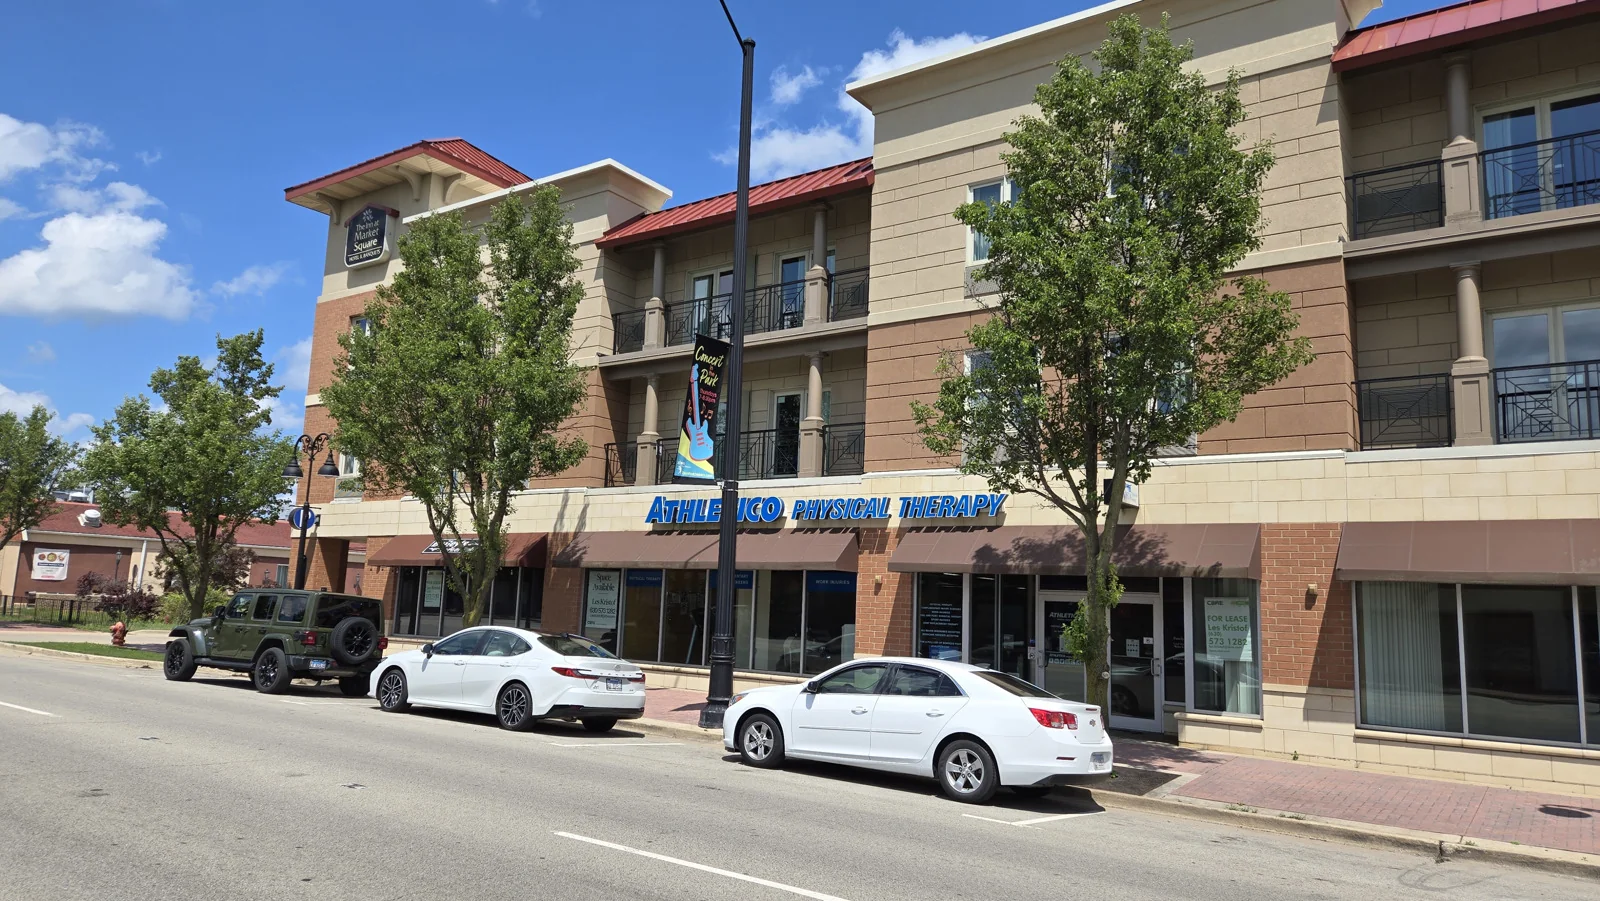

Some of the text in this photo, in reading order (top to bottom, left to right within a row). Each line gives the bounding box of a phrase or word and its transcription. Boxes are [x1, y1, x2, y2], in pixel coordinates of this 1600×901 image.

[356, 223, 365, 231] The
[365, 221, 373, 229] Inn
[354, 228, 379, 241] Market
[353, 238, 378, 252] Square
[695, 345, 724, 368] Concert
[699, 368, 719, 387] Park
[645, 493, 1007, 524] ATHLEICO PHYSICAL THERAPY
[596, 573, 612, 583] Space
[592, 583, 615, 592] Available
[600, 598, 616, 606] Kristof
[1048, 611, 1077, 619] ATHLETI
[1222, 624, 1248, 632] Kristof
[1209, 637, 1248, 645] 573 1282
